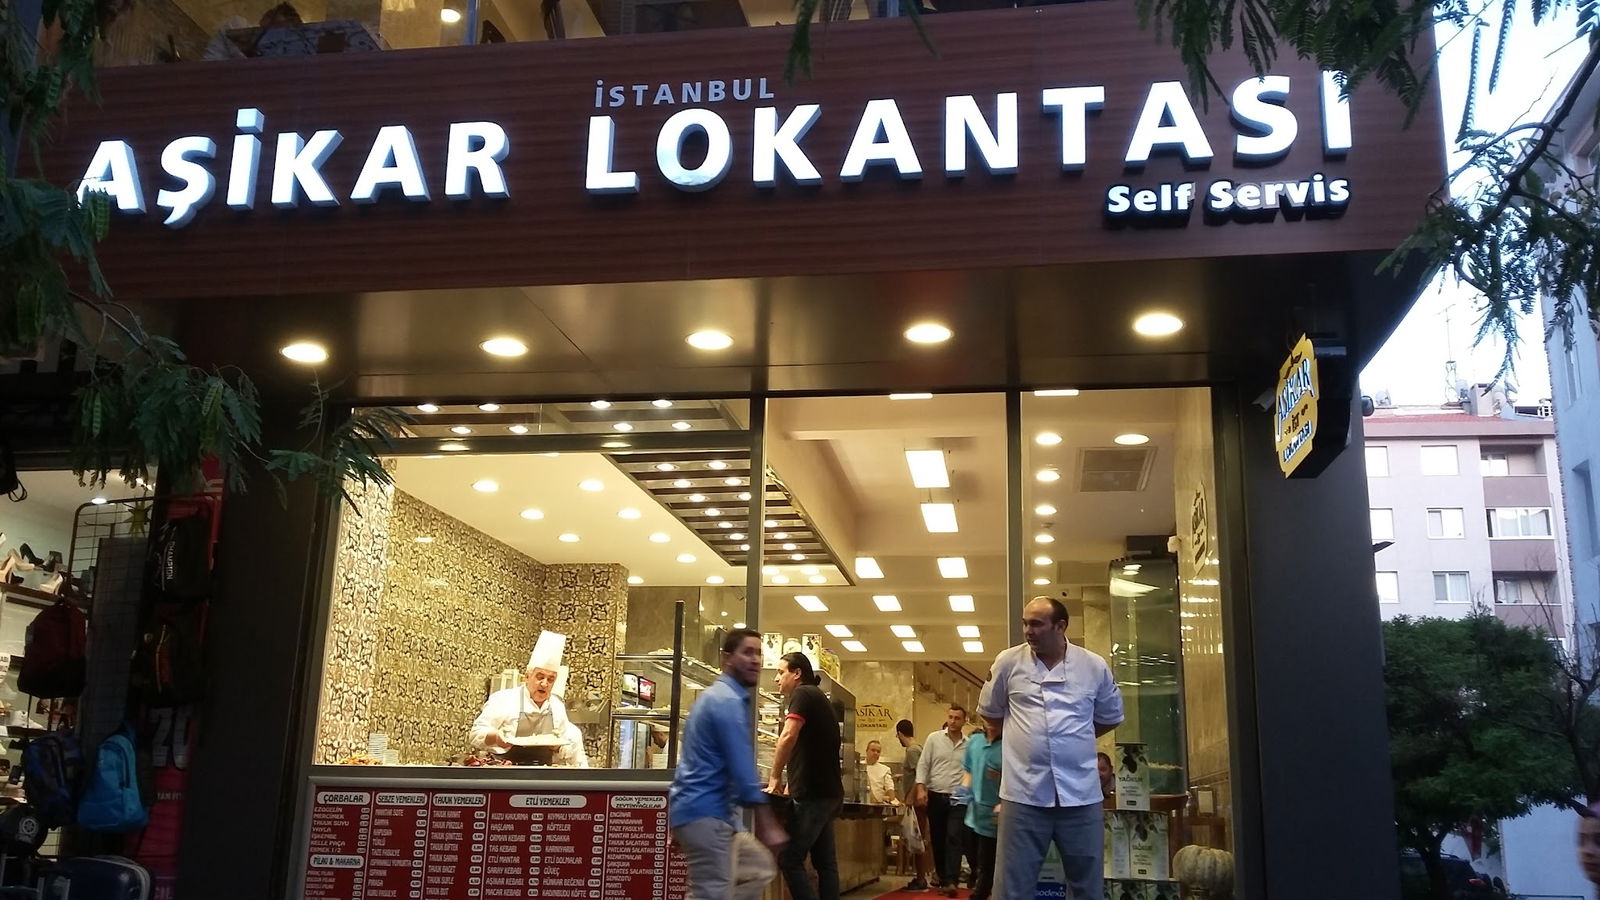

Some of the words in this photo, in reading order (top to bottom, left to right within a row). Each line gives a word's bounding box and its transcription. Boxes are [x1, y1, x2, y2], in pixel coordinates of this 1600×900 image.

[595, 78, 774, 108] İSTANBUL
[76, 107, 511, 229] AŞİKAR
[585, 70, 1353, 195] LOKANTASI
[1107, 183, 1194, 213] Self
[1209, 173, 1350, 211] Servis
[323, 794, 364, 804] ÇORBALAR
[526, 796, 538, 806] ETLİ
[540, 797, 570, 806] YEMEKLER
